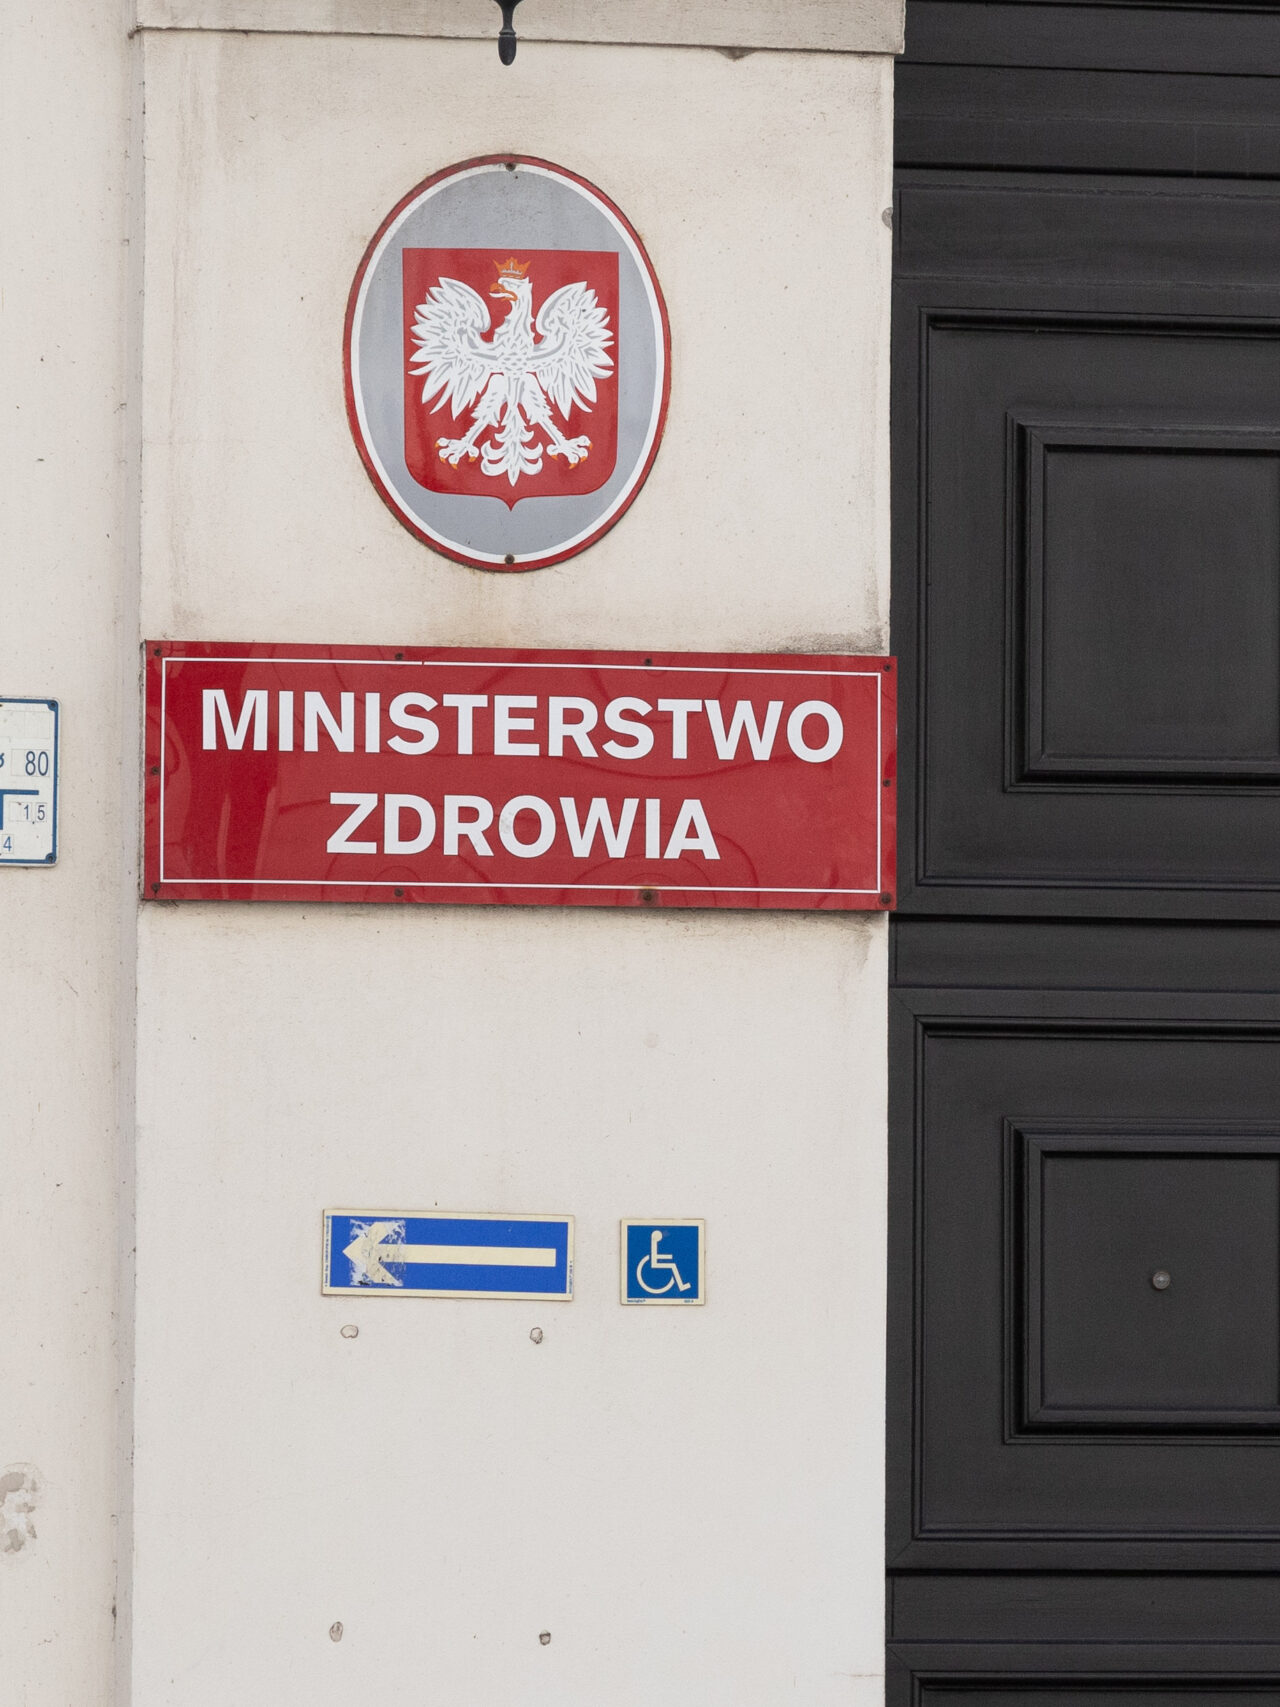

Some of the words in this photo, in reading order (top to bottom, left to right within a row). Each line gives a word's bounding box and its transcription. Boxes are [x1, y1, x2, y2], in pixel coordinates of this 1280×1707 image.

[201, 688, 844, 763] MINISTERSTWO
[25, 751, 49, 776] 80
[326, 792, 721, 860] ZDROWIA
